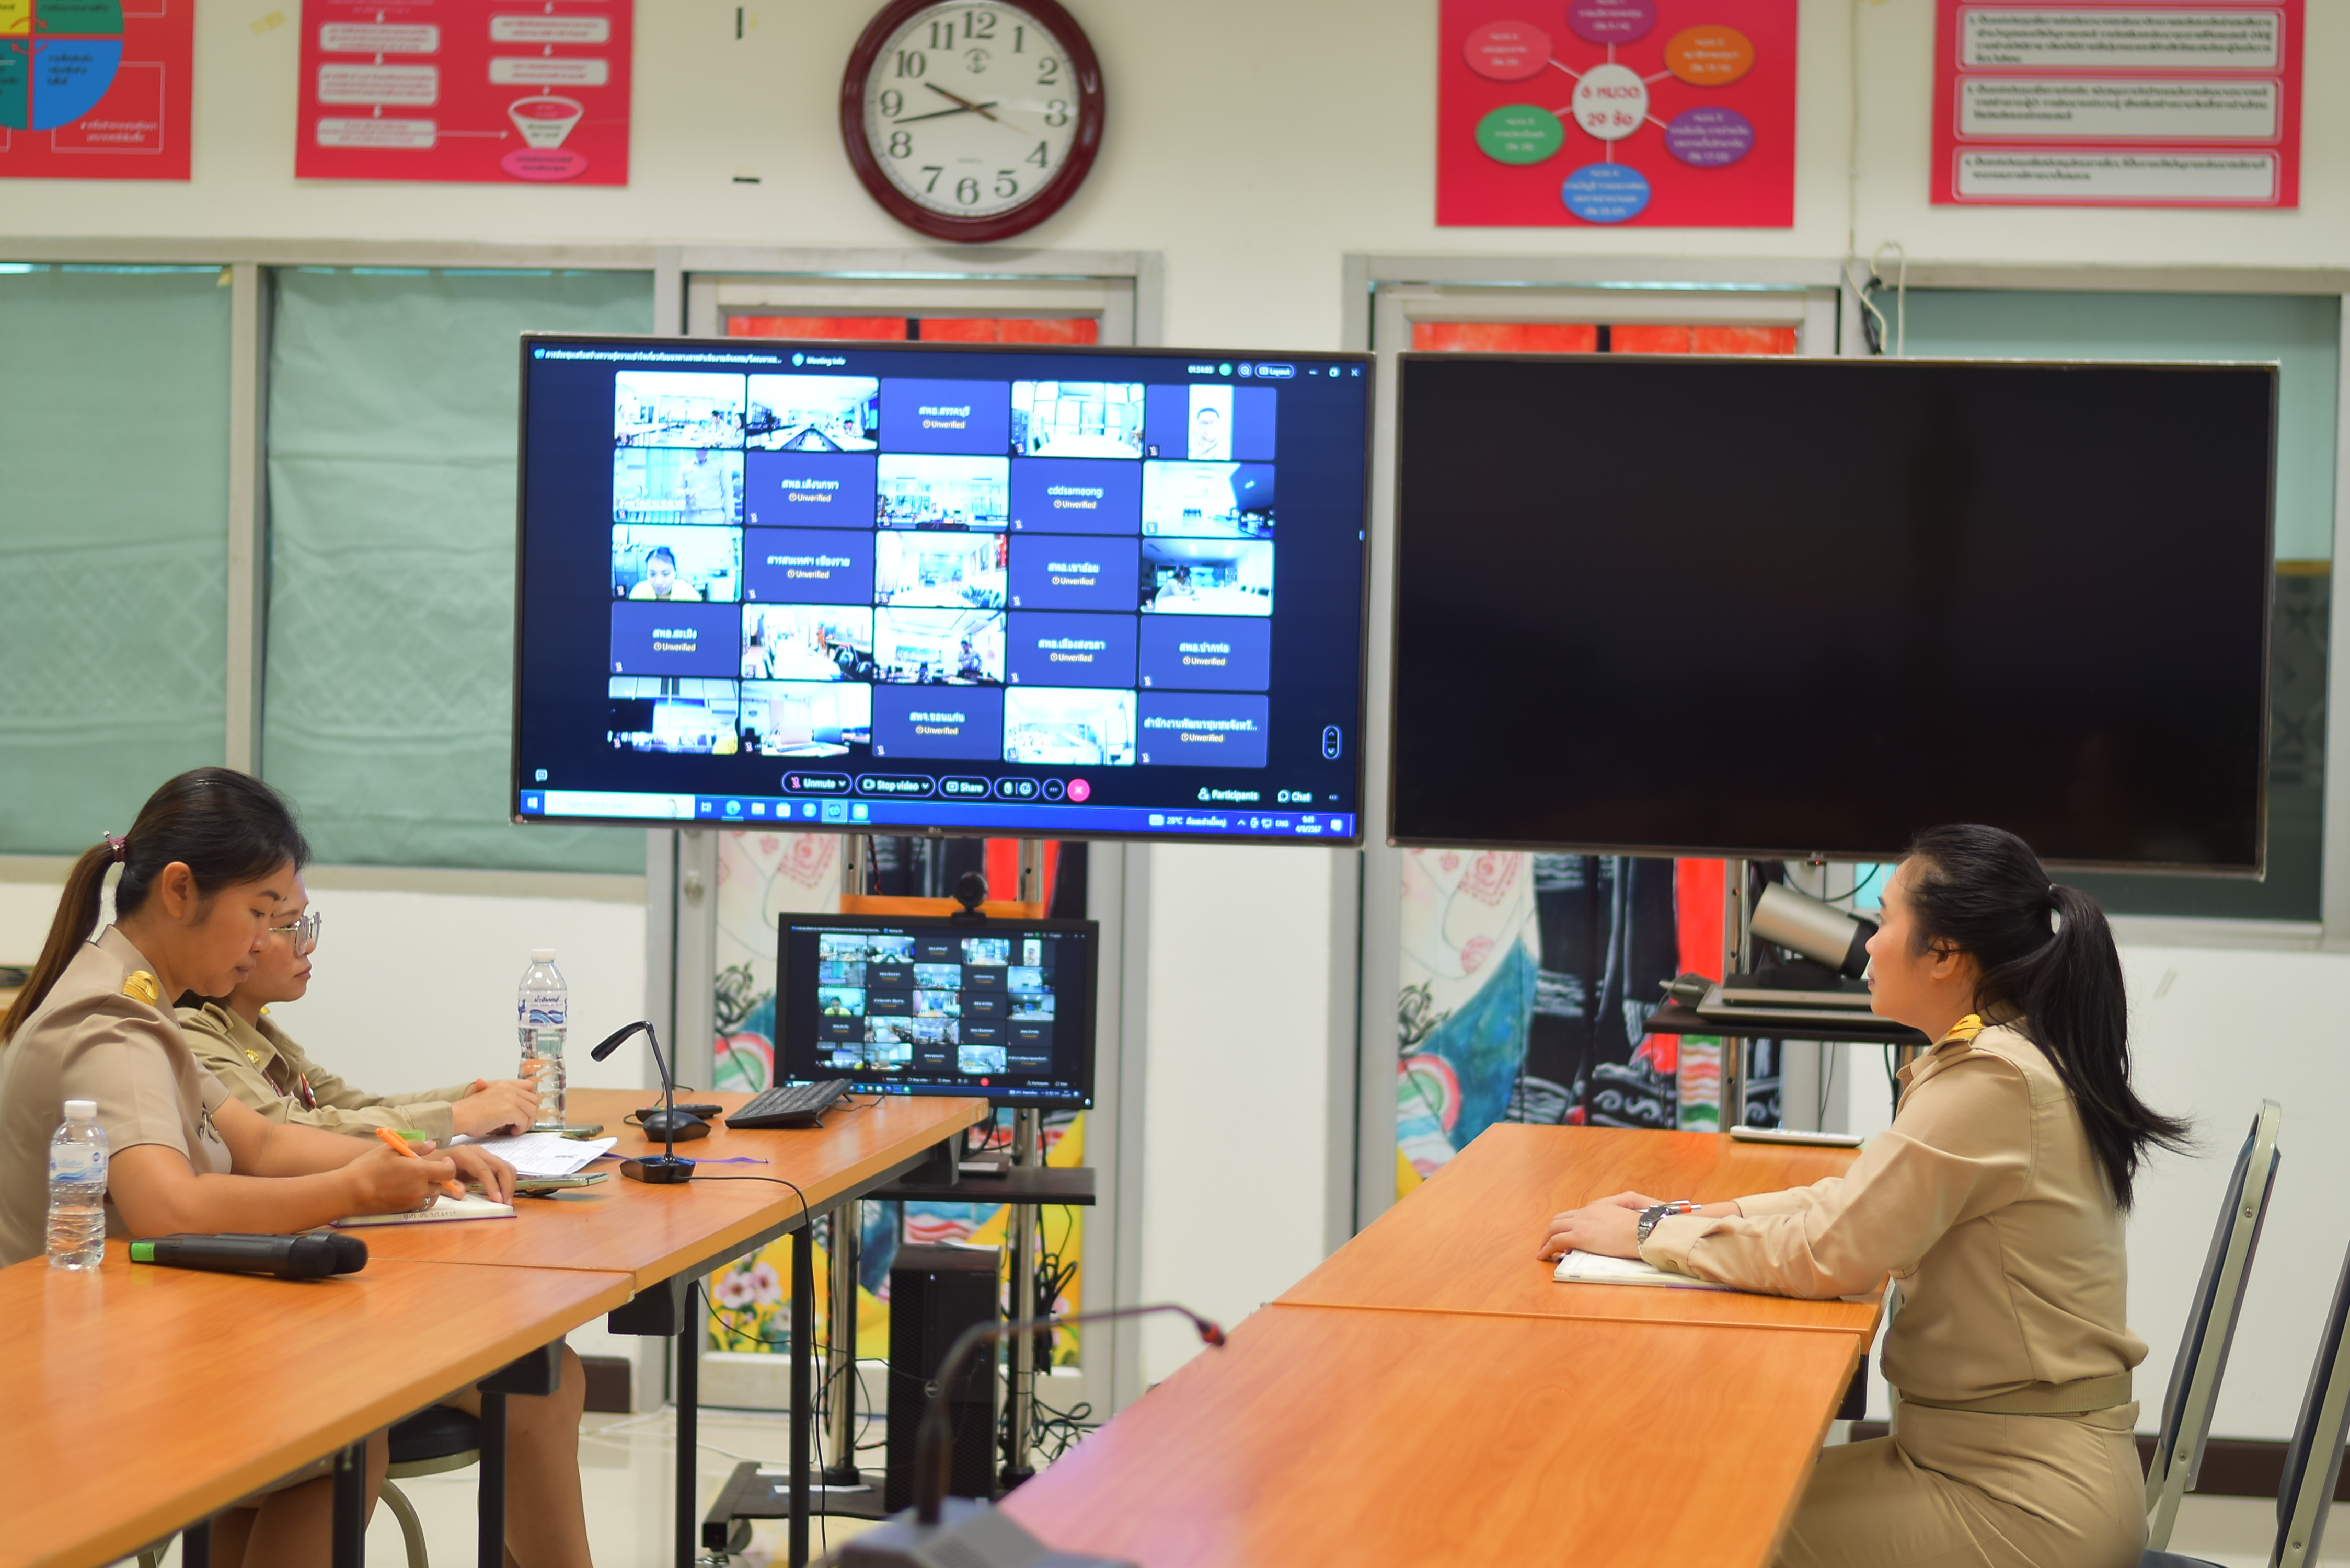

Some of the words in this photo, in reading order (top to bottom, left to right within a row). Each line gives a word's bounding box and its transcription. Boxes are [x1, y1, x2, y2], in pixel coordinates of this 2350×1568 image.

[929, 21, 954, 50] 11
[963, 11, 996, 39] 12
[1013, 25, 1024, 53] 1
[895, 51, 926, 78] 10
[1037, 57, 1058, 84] 2
[881, 89, 903, 117] 9
[1582, 85, 1591, 98] 6
[1597, 86, 1640, 99] หมวด
[1044, 100, 1068, 126] 3
[1588, 112, 1606, 125] 29
[1613, 110, 1633, 126] ข้อ
[889, 131, 912, 158] 8
[1026, 141, 1048, 168] 4
[921, 166, 944, 193] 7
[957, 178, 979, 205] 6
[994, 170, 1018, 198] 5
[807, 356, 832, 367] Meeting
[833, 357, 846, 365] Info
[1188, 365, 1214, 374] 01:34:03
[1270, 368, 1290, 376] Layout
[1047, 486, 1102, 498] cddsameong
[803, 779, 836, 788] Unmute
[877, 781, 896, 792] Stop
[897, 781, 919, 790] video
[960, 783, 983, 792] Share
[1212, 789, 1258, 801] Participants
[1292, 792, 1311, 801] Chat
